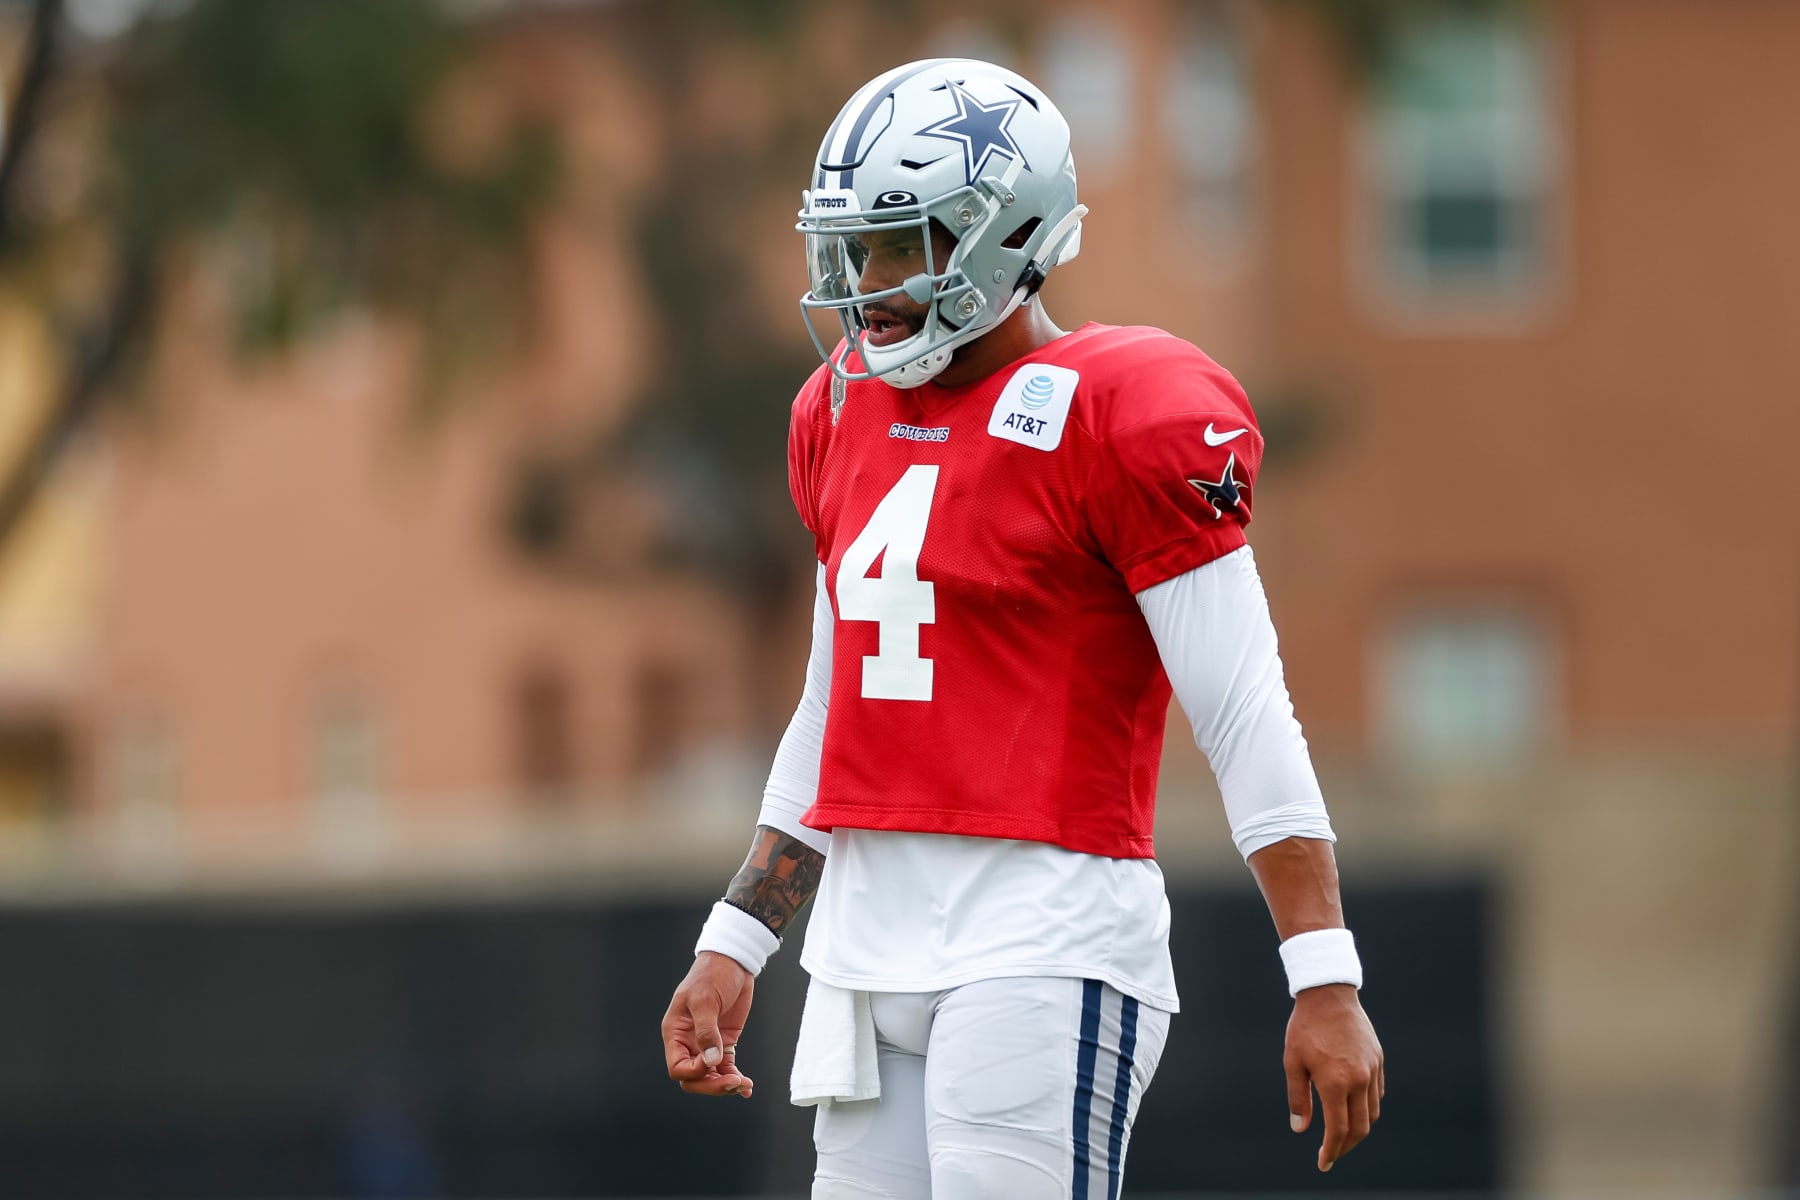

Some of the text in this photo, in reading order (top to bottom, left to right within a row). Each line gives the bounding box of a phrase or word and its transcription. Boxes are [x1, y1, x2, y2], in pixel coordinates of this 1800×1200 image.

[815, 198, 847, 208] COWBOYS
[889, 423, 949, 442] COWBOYS
[1003, 412, 1048, 436] AT&T
[836, 464, 940, 701] 4
